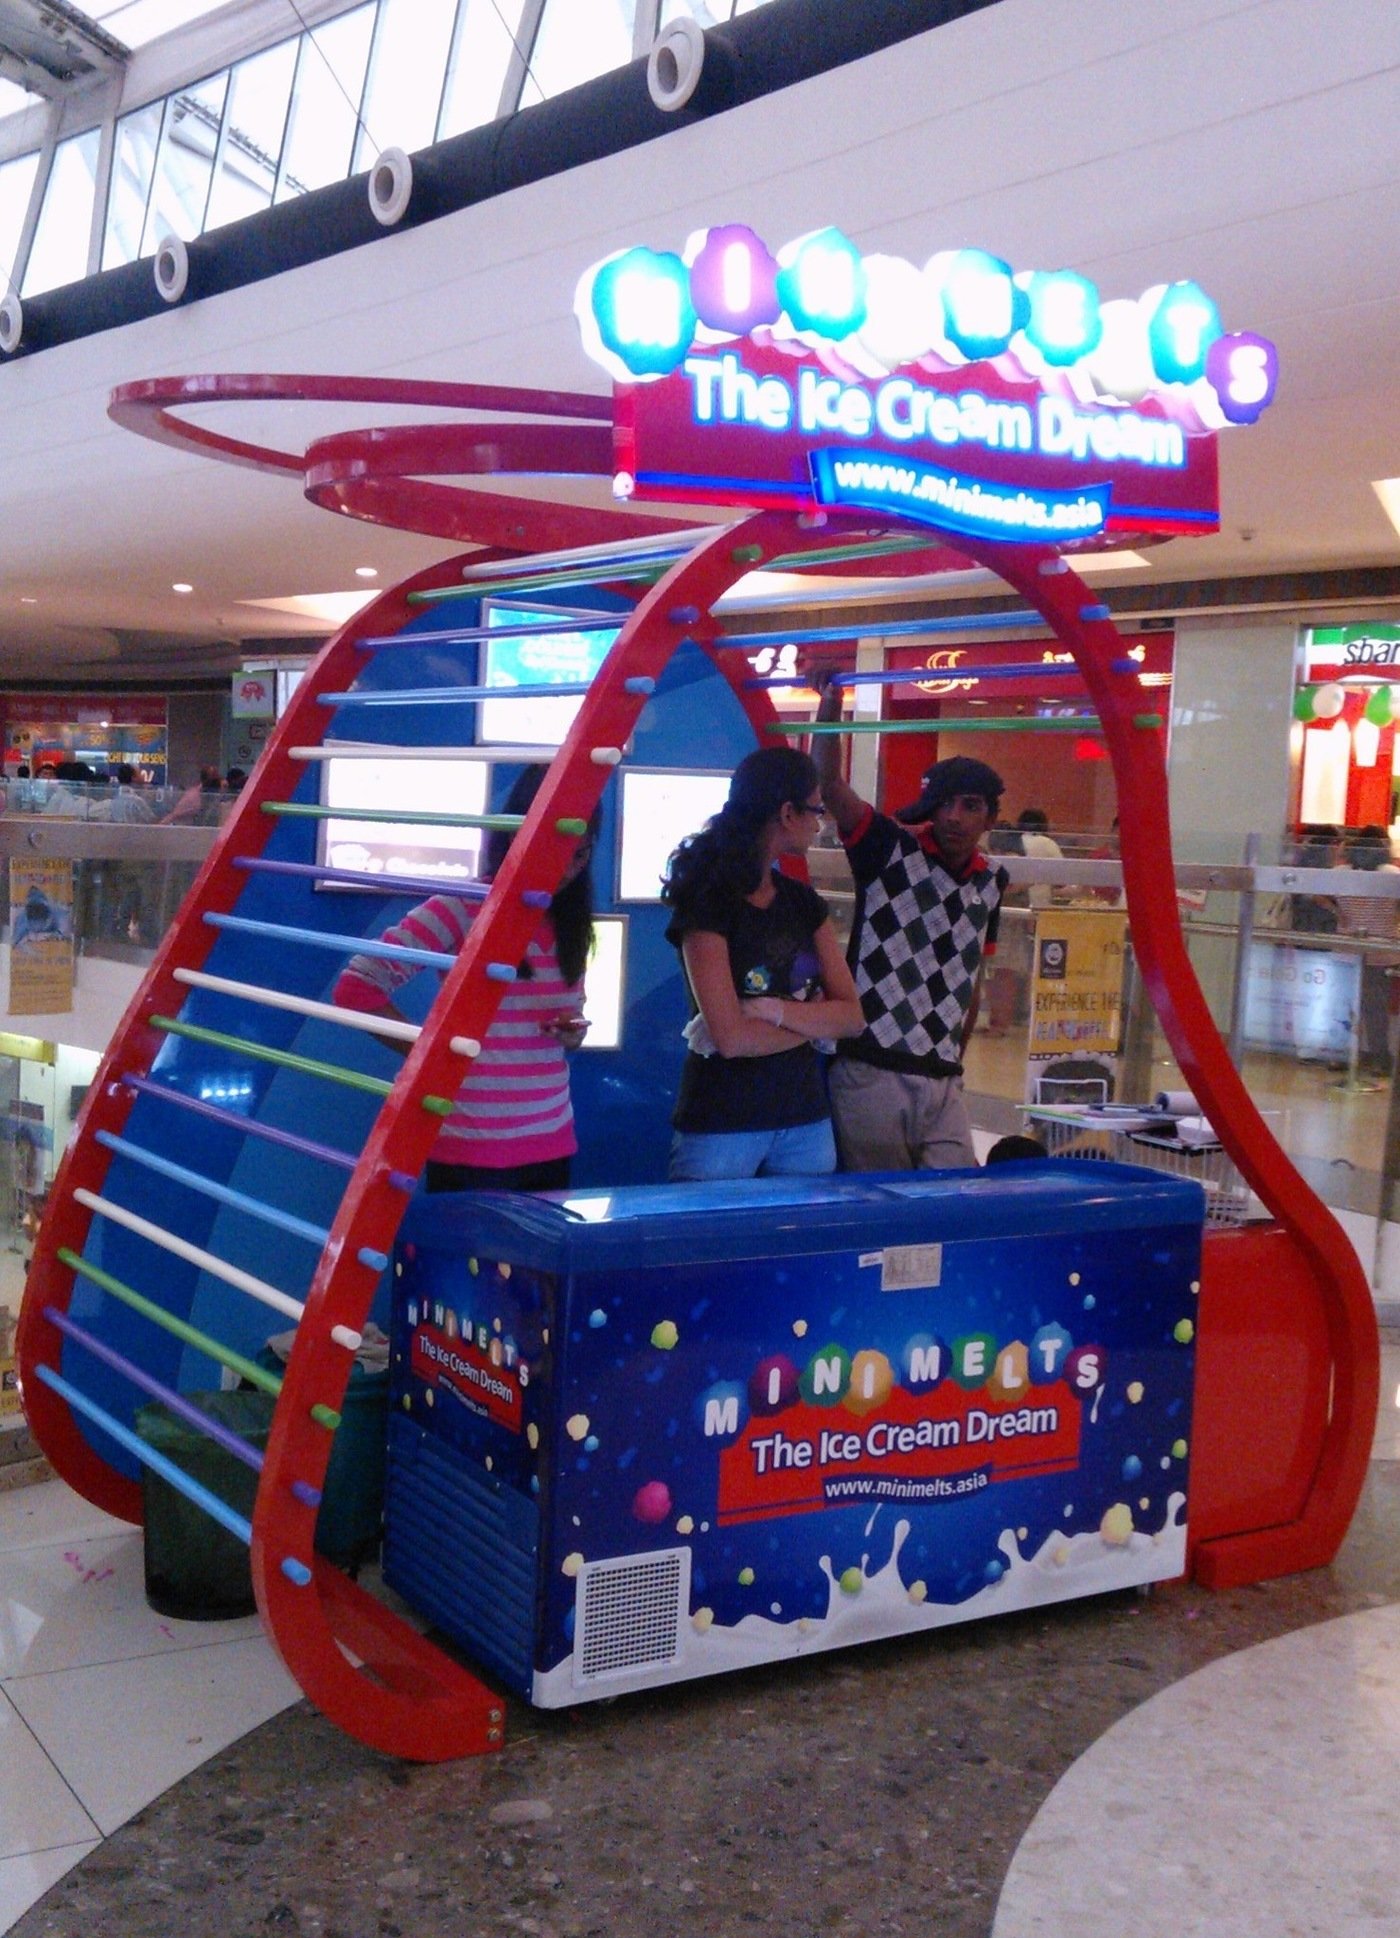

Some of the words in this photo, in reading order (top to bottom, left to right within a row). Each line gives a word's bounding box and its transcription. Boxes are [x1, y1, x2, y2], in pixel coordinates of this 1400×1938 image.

[685, 355, 790, 428] The
[802, 371, 872, 434] Ice
[878, 380, 1032, 449] Cream
[1040, 397, 1185, 465] Dream
[834, 461, 1103, 529] www.minimelts.asia
[408, 1299, 529, 1387] MINIMELTS
[420, 1336, 436, 1360] The
[437, 1346, 449, 1367] Ice
[450, 1353, 480, 1384] Cream
[480, 1369, 513, 1404] Dream
[704, 1340, 1099, 1436] MINIMELTS
[752, 1433, 812, 1473] The
[820, 1432, 861, 1464] Ice
[866, 1421, 960, 1456] Cream
[966, 1408, 1057, 1442] Dream
[826, 1472, 988, 1497] www.minimelts.asia
